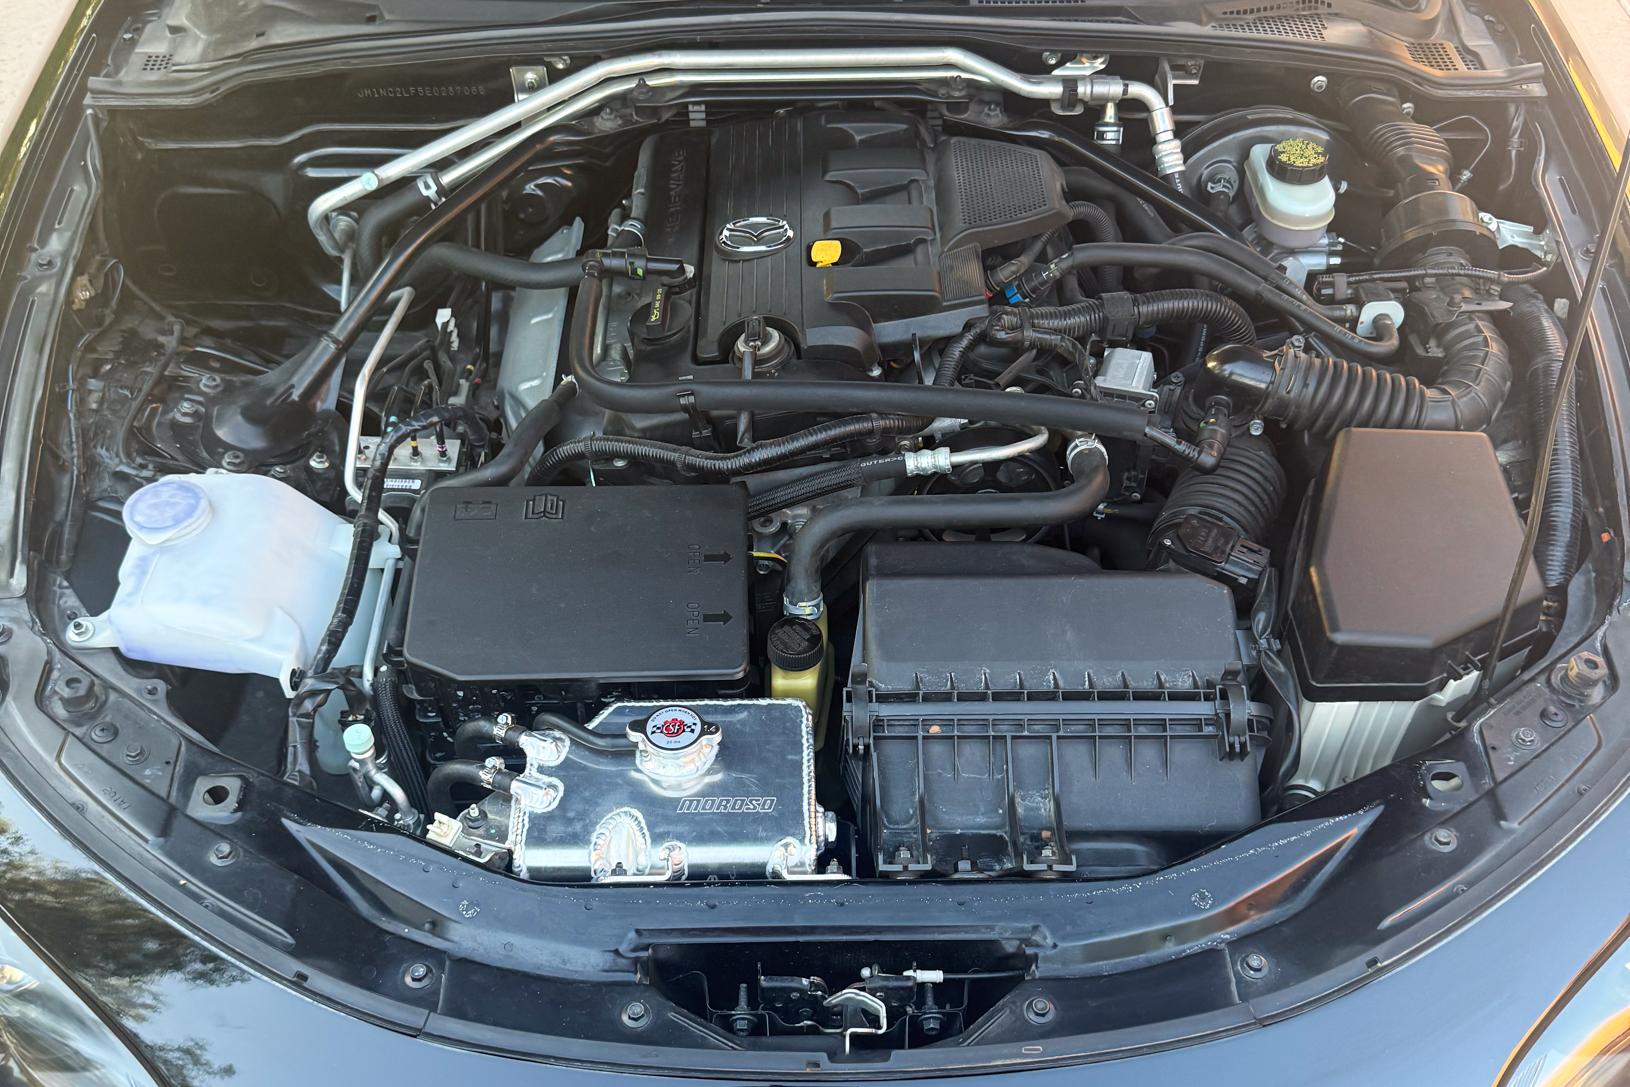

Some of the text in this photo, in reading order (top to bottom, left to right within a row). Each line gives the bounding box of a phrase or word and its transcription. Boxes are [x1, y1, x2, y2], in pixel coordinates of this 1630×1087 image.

[687, 544, 701, 575] OPEN
[686, 602, 701, 636] OPEN
[663, 722, 681, 734] CSF
[676, 797, 777, 813] MOROSO
